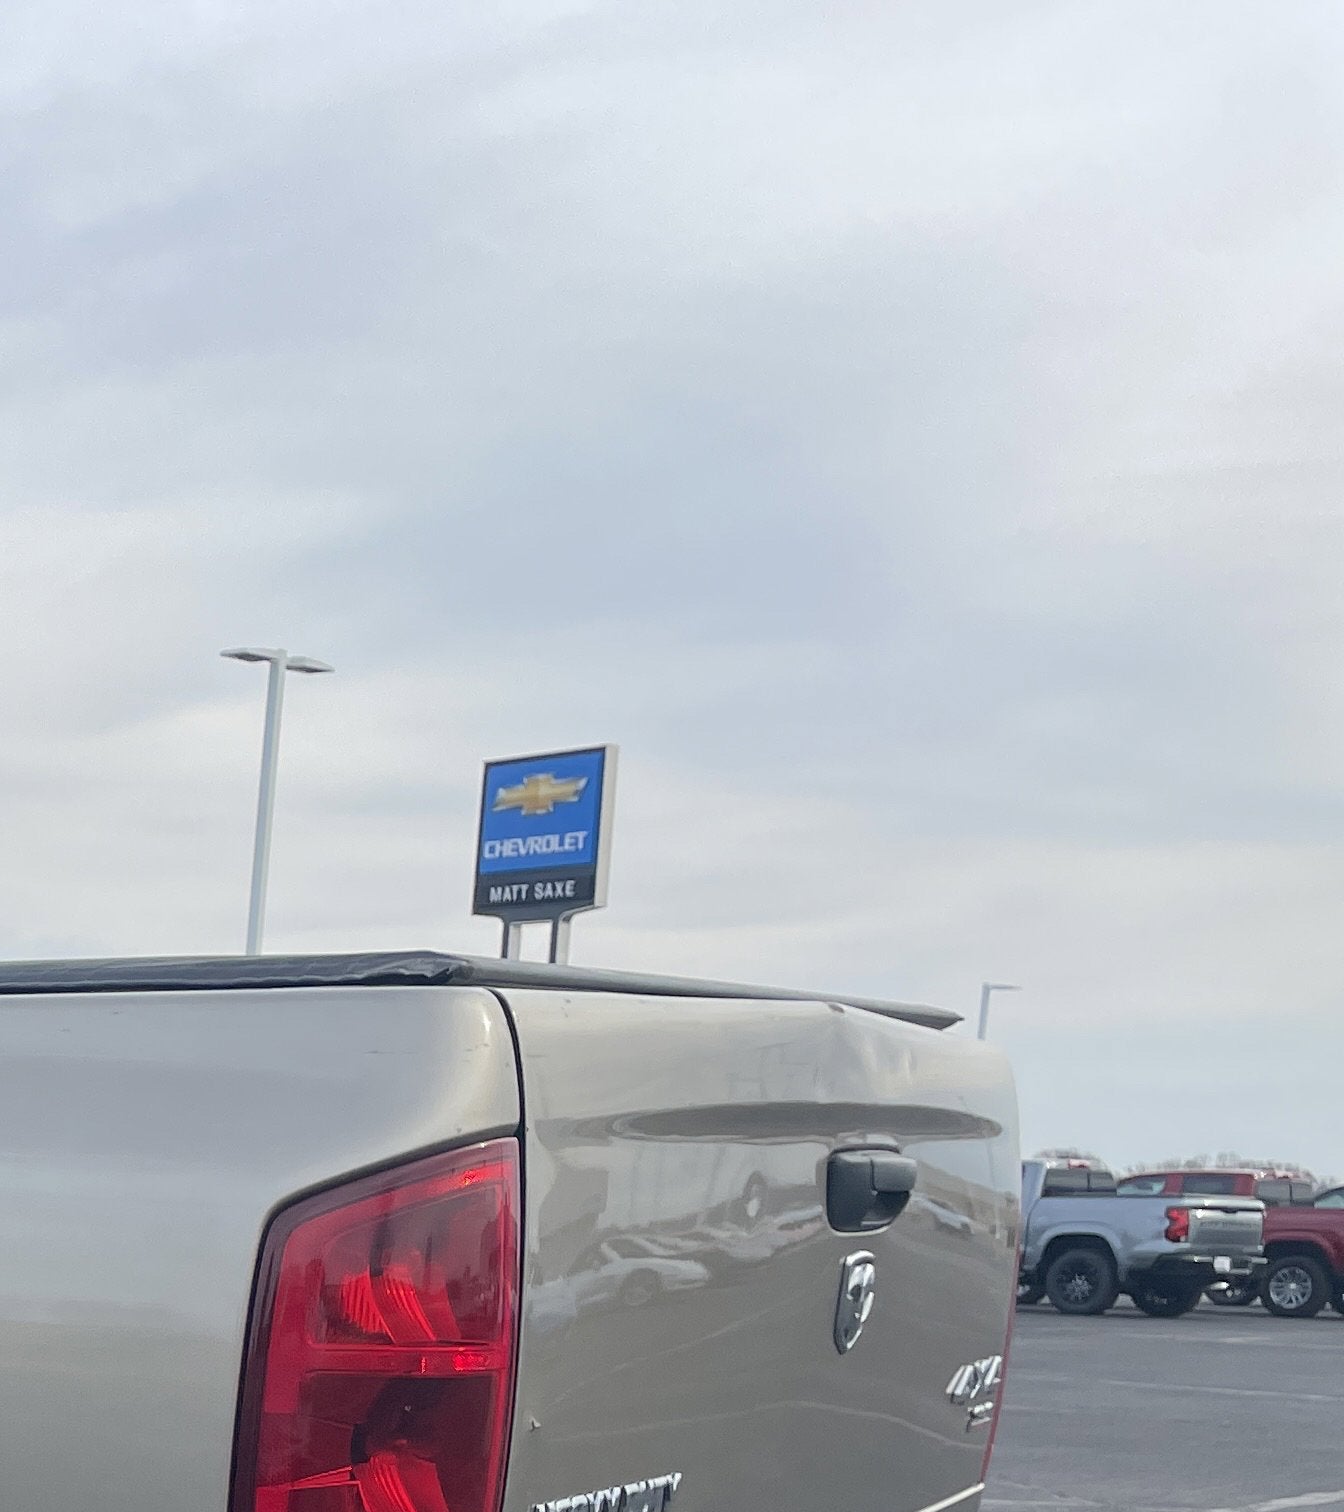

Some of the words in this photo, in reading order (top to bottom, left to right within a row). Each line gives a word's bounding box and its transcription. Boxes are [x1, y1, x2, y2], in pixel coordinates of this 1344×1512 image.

[483, 831, 588, 859] CHEVROLET
[489, 884, 529, 903] MATT
[534, 880, 576, 901] SAXE
